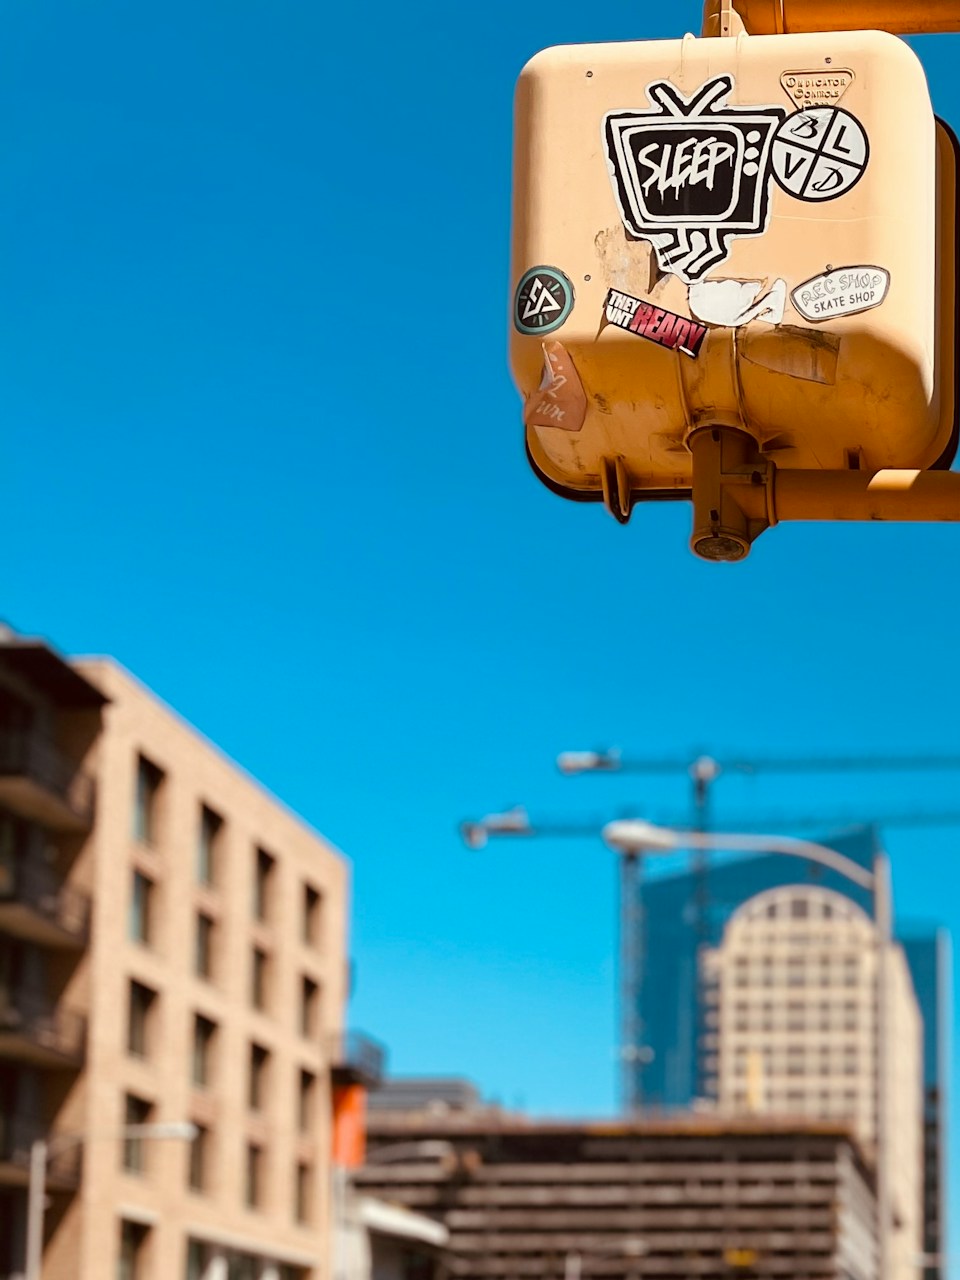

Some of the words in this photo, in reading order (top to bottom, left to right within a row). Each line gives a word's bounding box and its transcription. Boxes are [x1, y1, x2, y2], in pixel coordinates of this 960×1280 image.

[637, 137, 736, 203] SLEEP
[607, 290, 641, 315] THEY
[801, 278, 836, 307] REC
[839, 273, 882, 291] SHOP
[814, 296, 845, 313] SKATE
[849, 291, 875, 304] SHOP
[630, 302, 706, 351] READY
